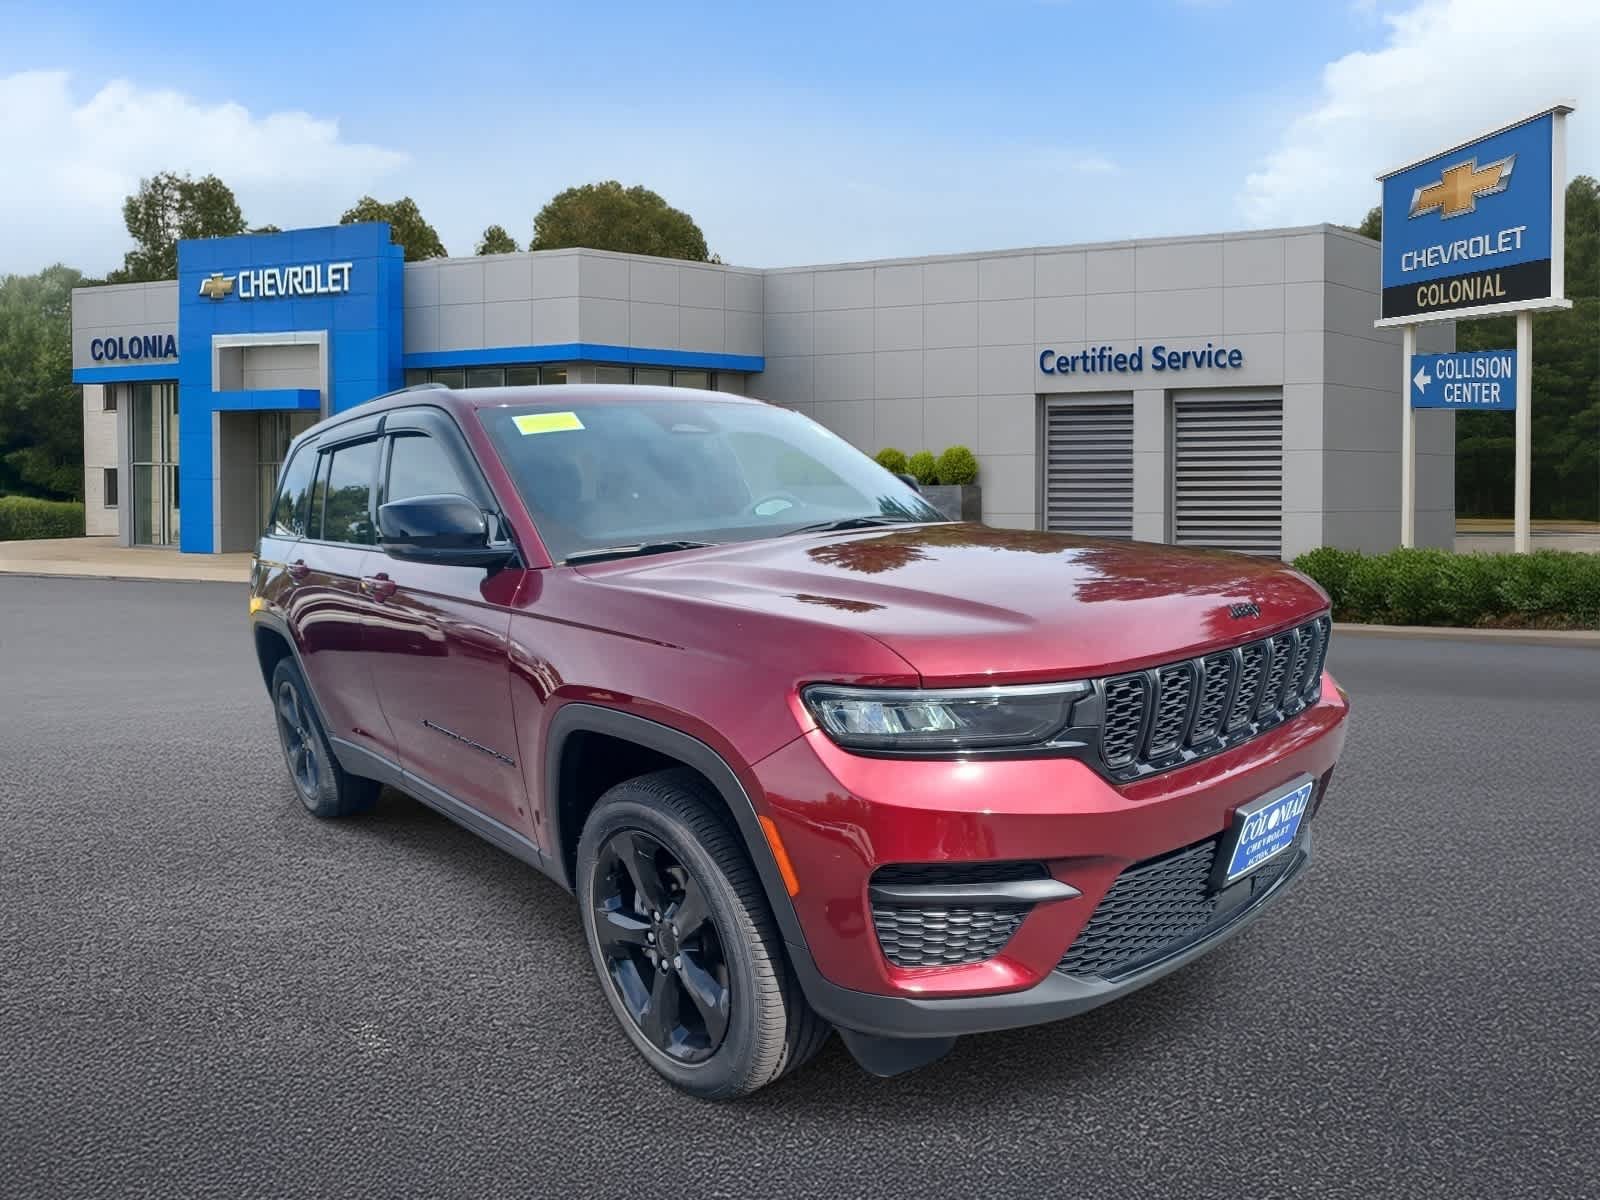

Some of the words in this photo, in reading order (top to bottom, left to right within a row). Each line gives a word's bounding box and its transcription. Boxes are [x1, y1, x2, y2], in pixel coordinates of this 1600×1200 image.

[1400, 225, 1527, 272] CHEVROLET
[238, 262, 353, 298] CHEVROLET
[1416, 273, 1506, 307] COLONIAL
[90, 334, 178, 361] COLONIA
[1039, 346, 1144, 374] Certified
[1151, 343, 1243, 371] Service
[1436, 356, 1512, 379] COLLISION
[1444, 382, 1501, 403] CENTER
[1241, 792, 1306, 845] COLONIAL
